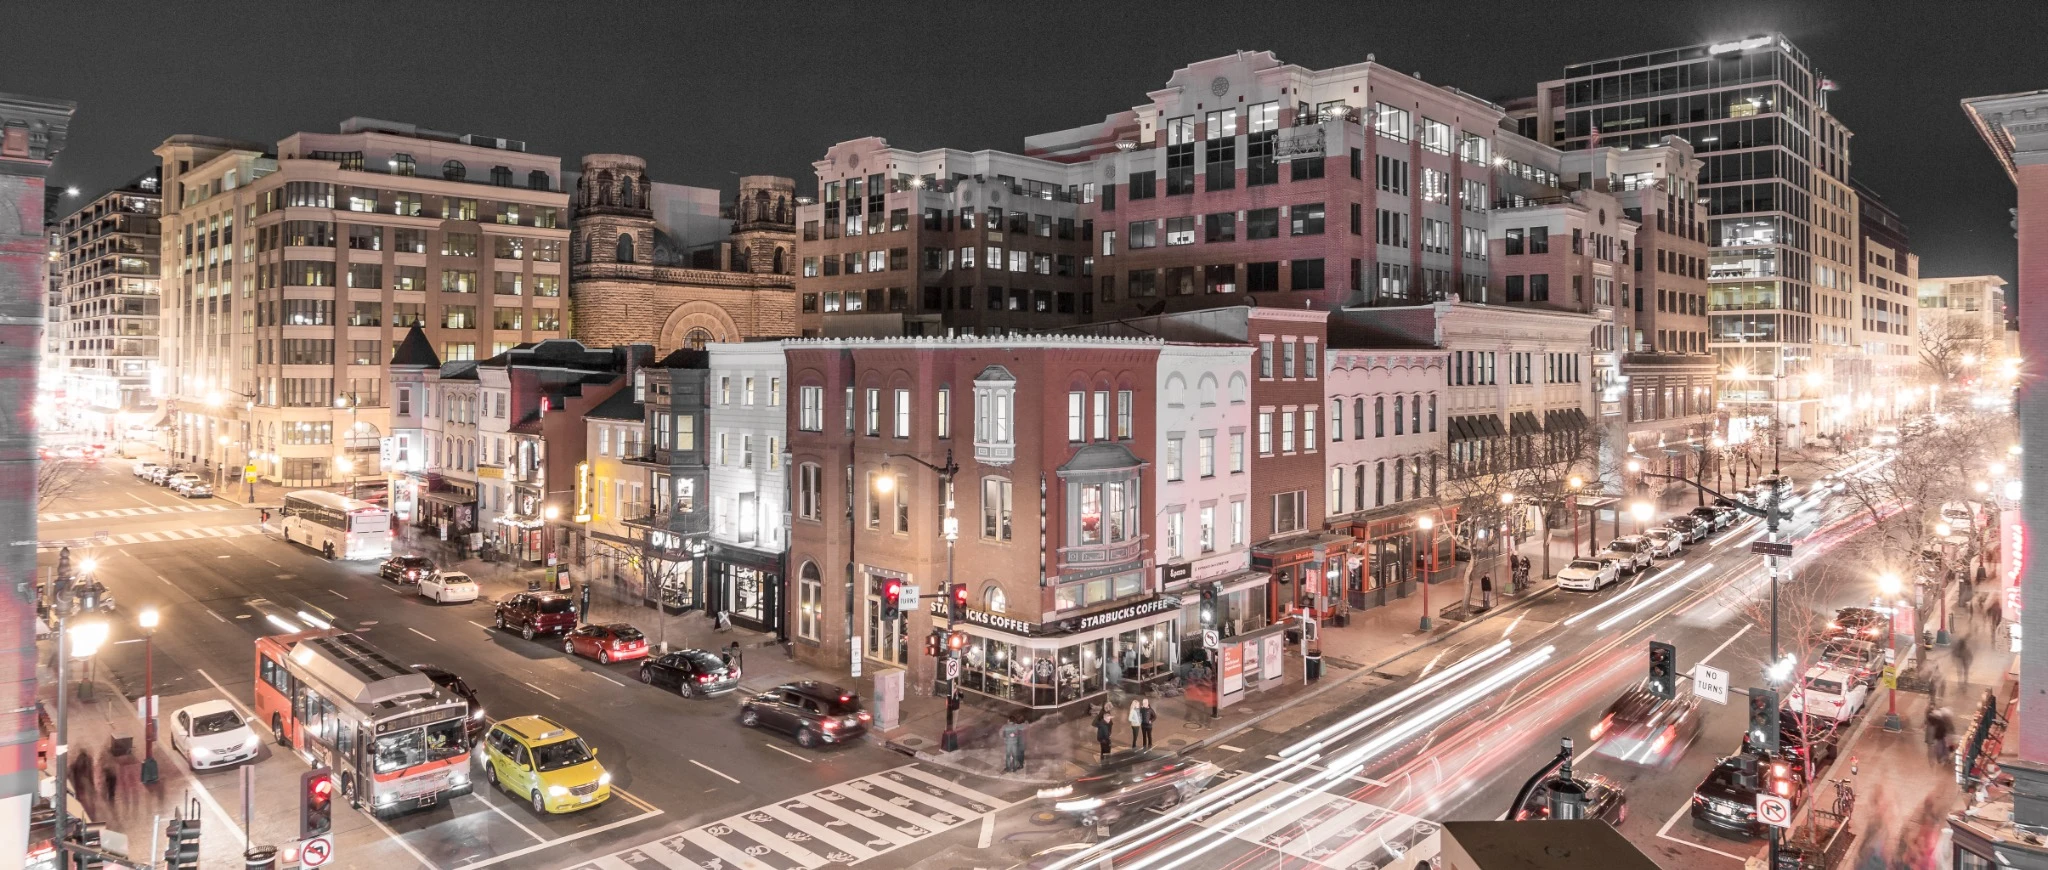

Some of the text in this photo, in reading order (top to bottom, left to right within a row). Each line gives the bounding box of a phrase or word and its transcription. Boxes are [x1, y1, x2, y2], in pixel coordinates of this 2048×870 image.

[900, 597, 917, 605] TURNS
[930, 602, 1030, 633] STACKS COFFEE
[1080, 599, 1168, 629] STARBUCKS COFFEE
[1706, 671, 1717, 679] NO
[1698, 681, 1723, 694] TURNS
